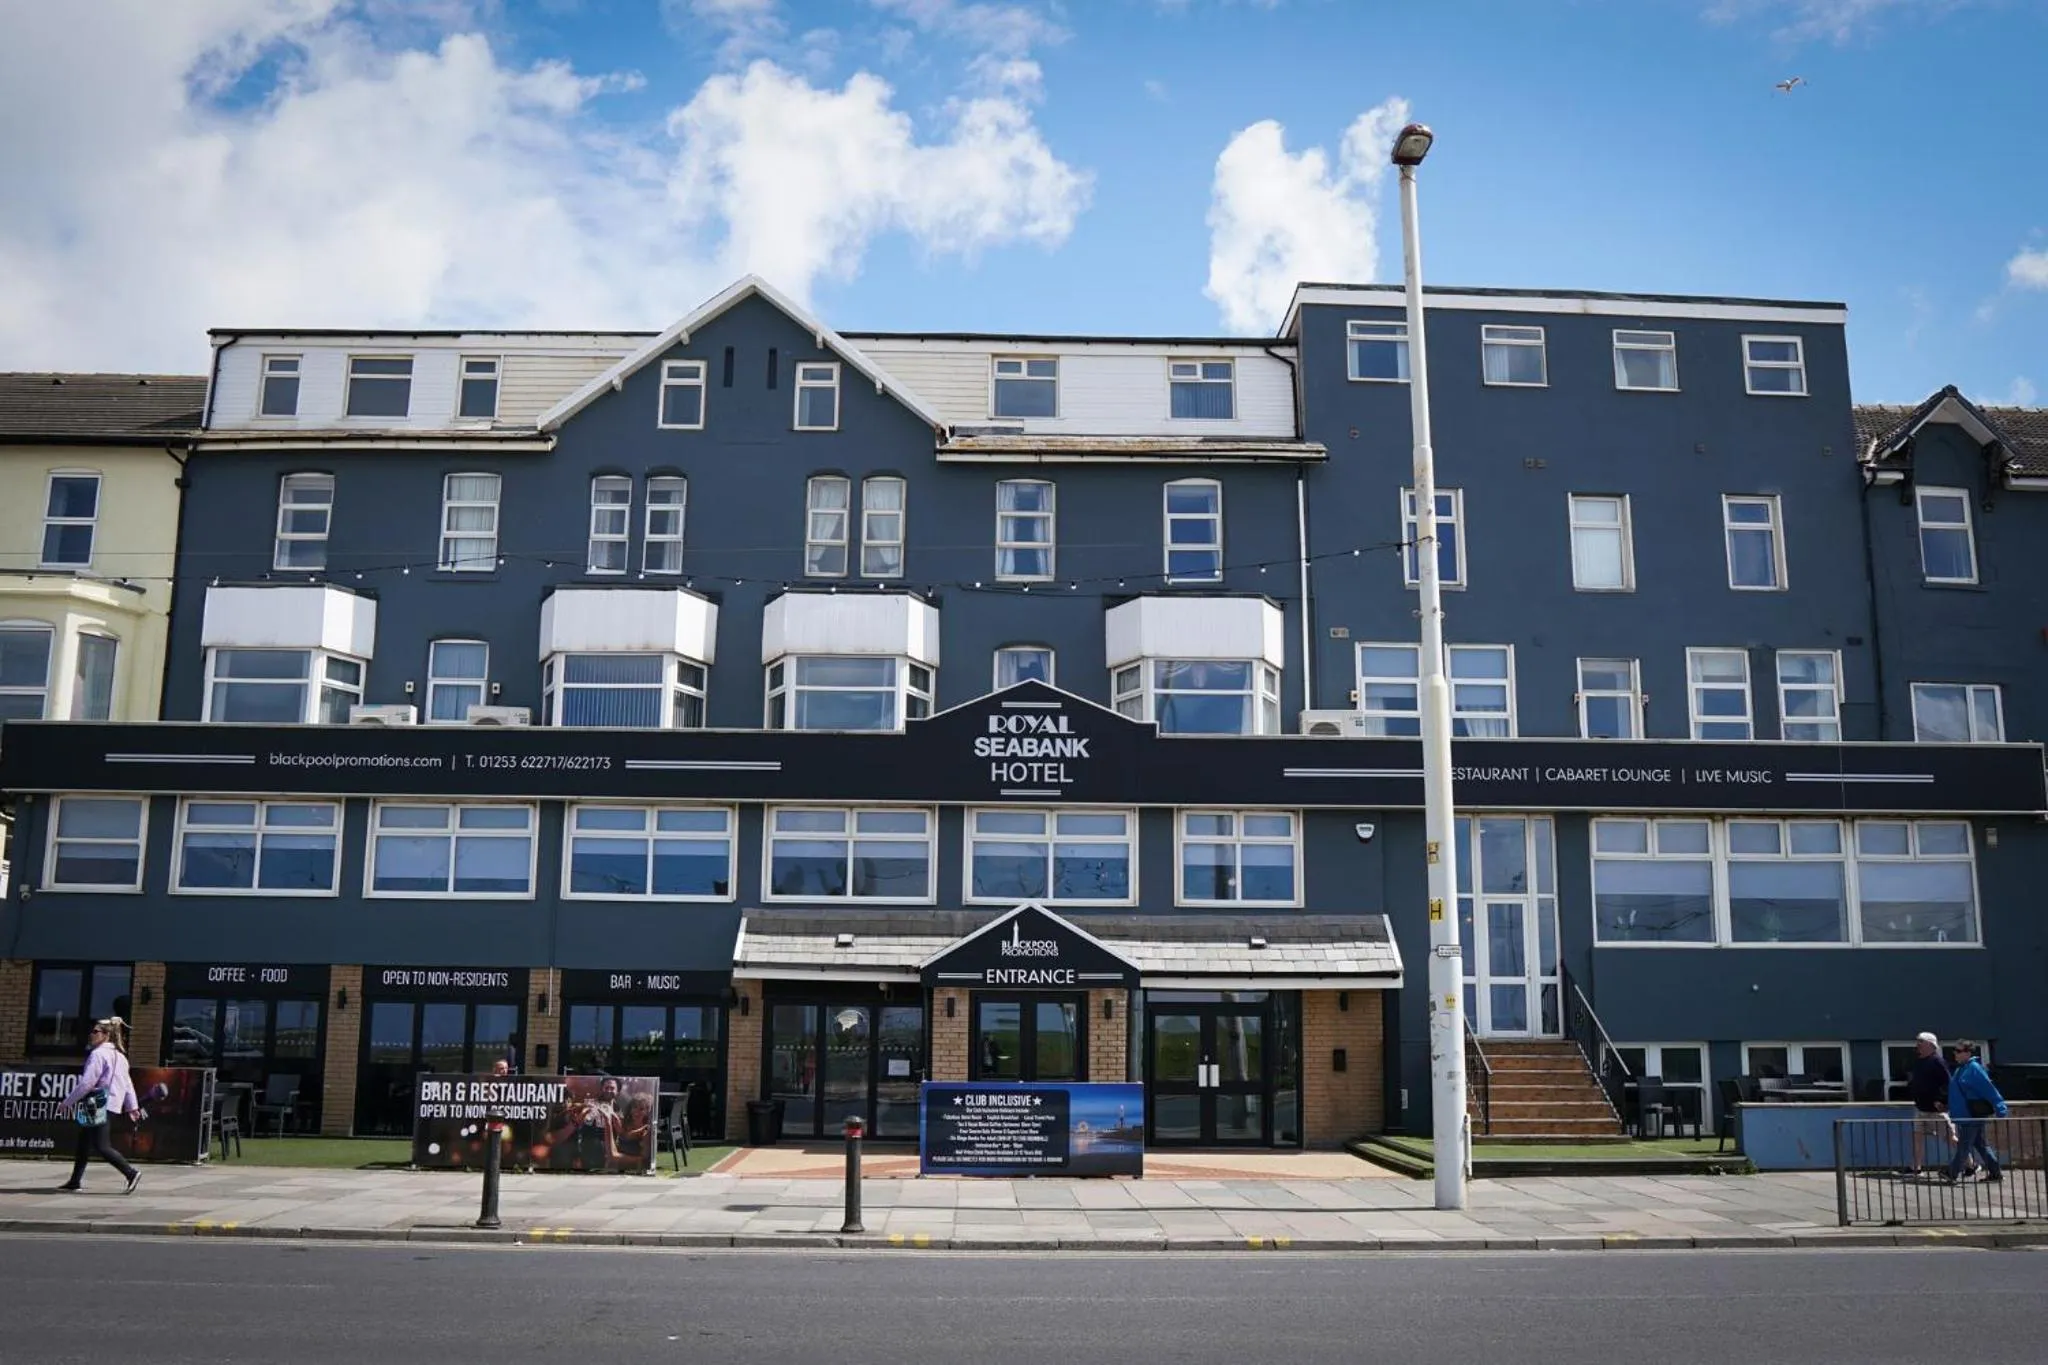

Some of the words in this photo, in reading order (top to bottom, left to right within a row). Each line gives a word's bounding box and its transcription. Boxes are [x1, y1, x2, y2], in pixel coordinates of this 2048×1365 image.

[988, 714, 1076, 734] ROYAL
[974, 736, 1090, 758] SEABANK
[269, 752, 442, 769] blackpoolpromotions.com
[479, 755, 517, 768] 01253
[520, 756, 612, 770] 622717/622173
[991, 762, 1074, 783] HOTEL
[1450, 767, 1529, 781] ESTAURANT
[1545, 767, 1609, 781] CABARET
[1611, 768, 1672, 782] LOUNGE
[1695, 769, 1722, 783] LIVE
[1726, 770, 1773, 783] MUSIC
[208, 967, 246, 982] COFFEE
[260, 968, 288, 983] FOOD
[382, 970, 410, 985] OPEN
[412, 971, 426, 986] TO
[427, 971, 509, 987] NON-RESIDENTS
[610, 974, 632, 989] BAR
[647, 975, 680, 990] MUSIC
[986, 968, 1075, 984] ENTRANCE
[39, 1073, 83, 1098] SHO
[421, 1081, 452, 1102] BAR
[455, 1081, 467, 1102] &
[470, 1082, 568, 1104] RESTAURANT
[965, 1094, 987, 1106] CLUB
[989, 1094, 1032, 1107] INCLUSIVE
[420, 1103, 447, 1118] OPEN
[449, 1104, 463, 1118] TO
[28, 1138, 55, 1149] details
